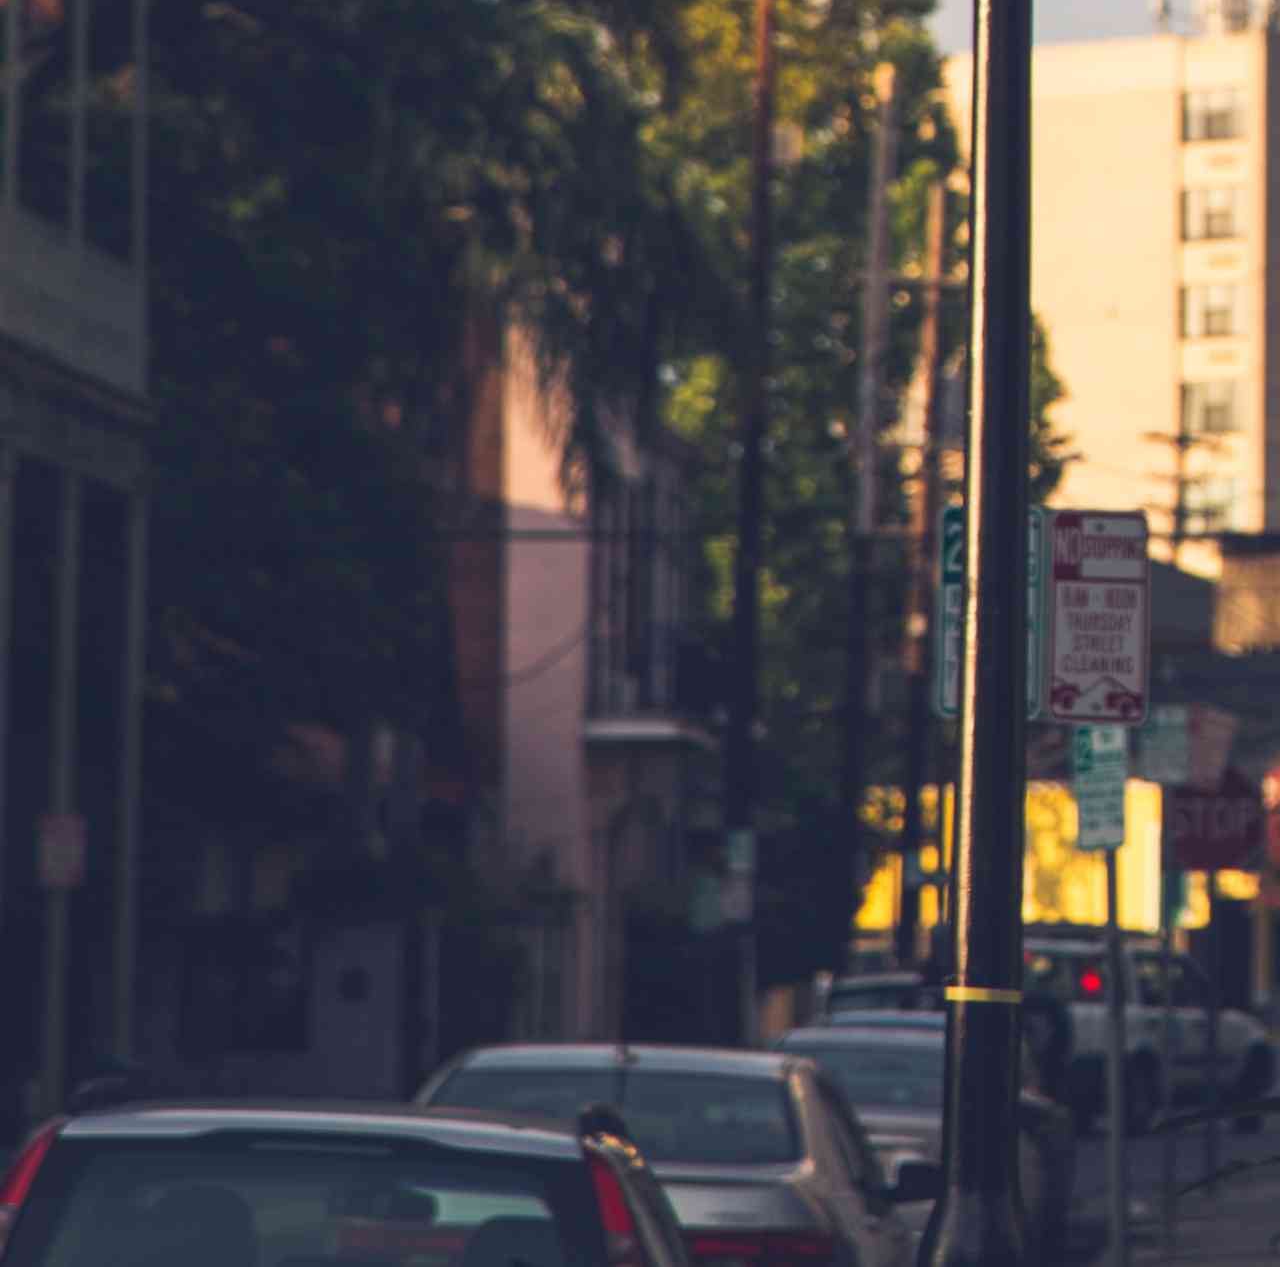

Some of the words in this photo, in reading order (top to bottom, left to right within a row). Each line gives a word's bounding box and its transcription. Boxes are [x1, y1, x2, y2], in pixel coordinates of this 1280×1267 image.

[1055, 527, 1081, 565] NO
[1065, 611, 1132, 632] THURSDAY
[1072, 633, 1124, 654] STREET
[1062, 653, 1133, 674] CLEANING
